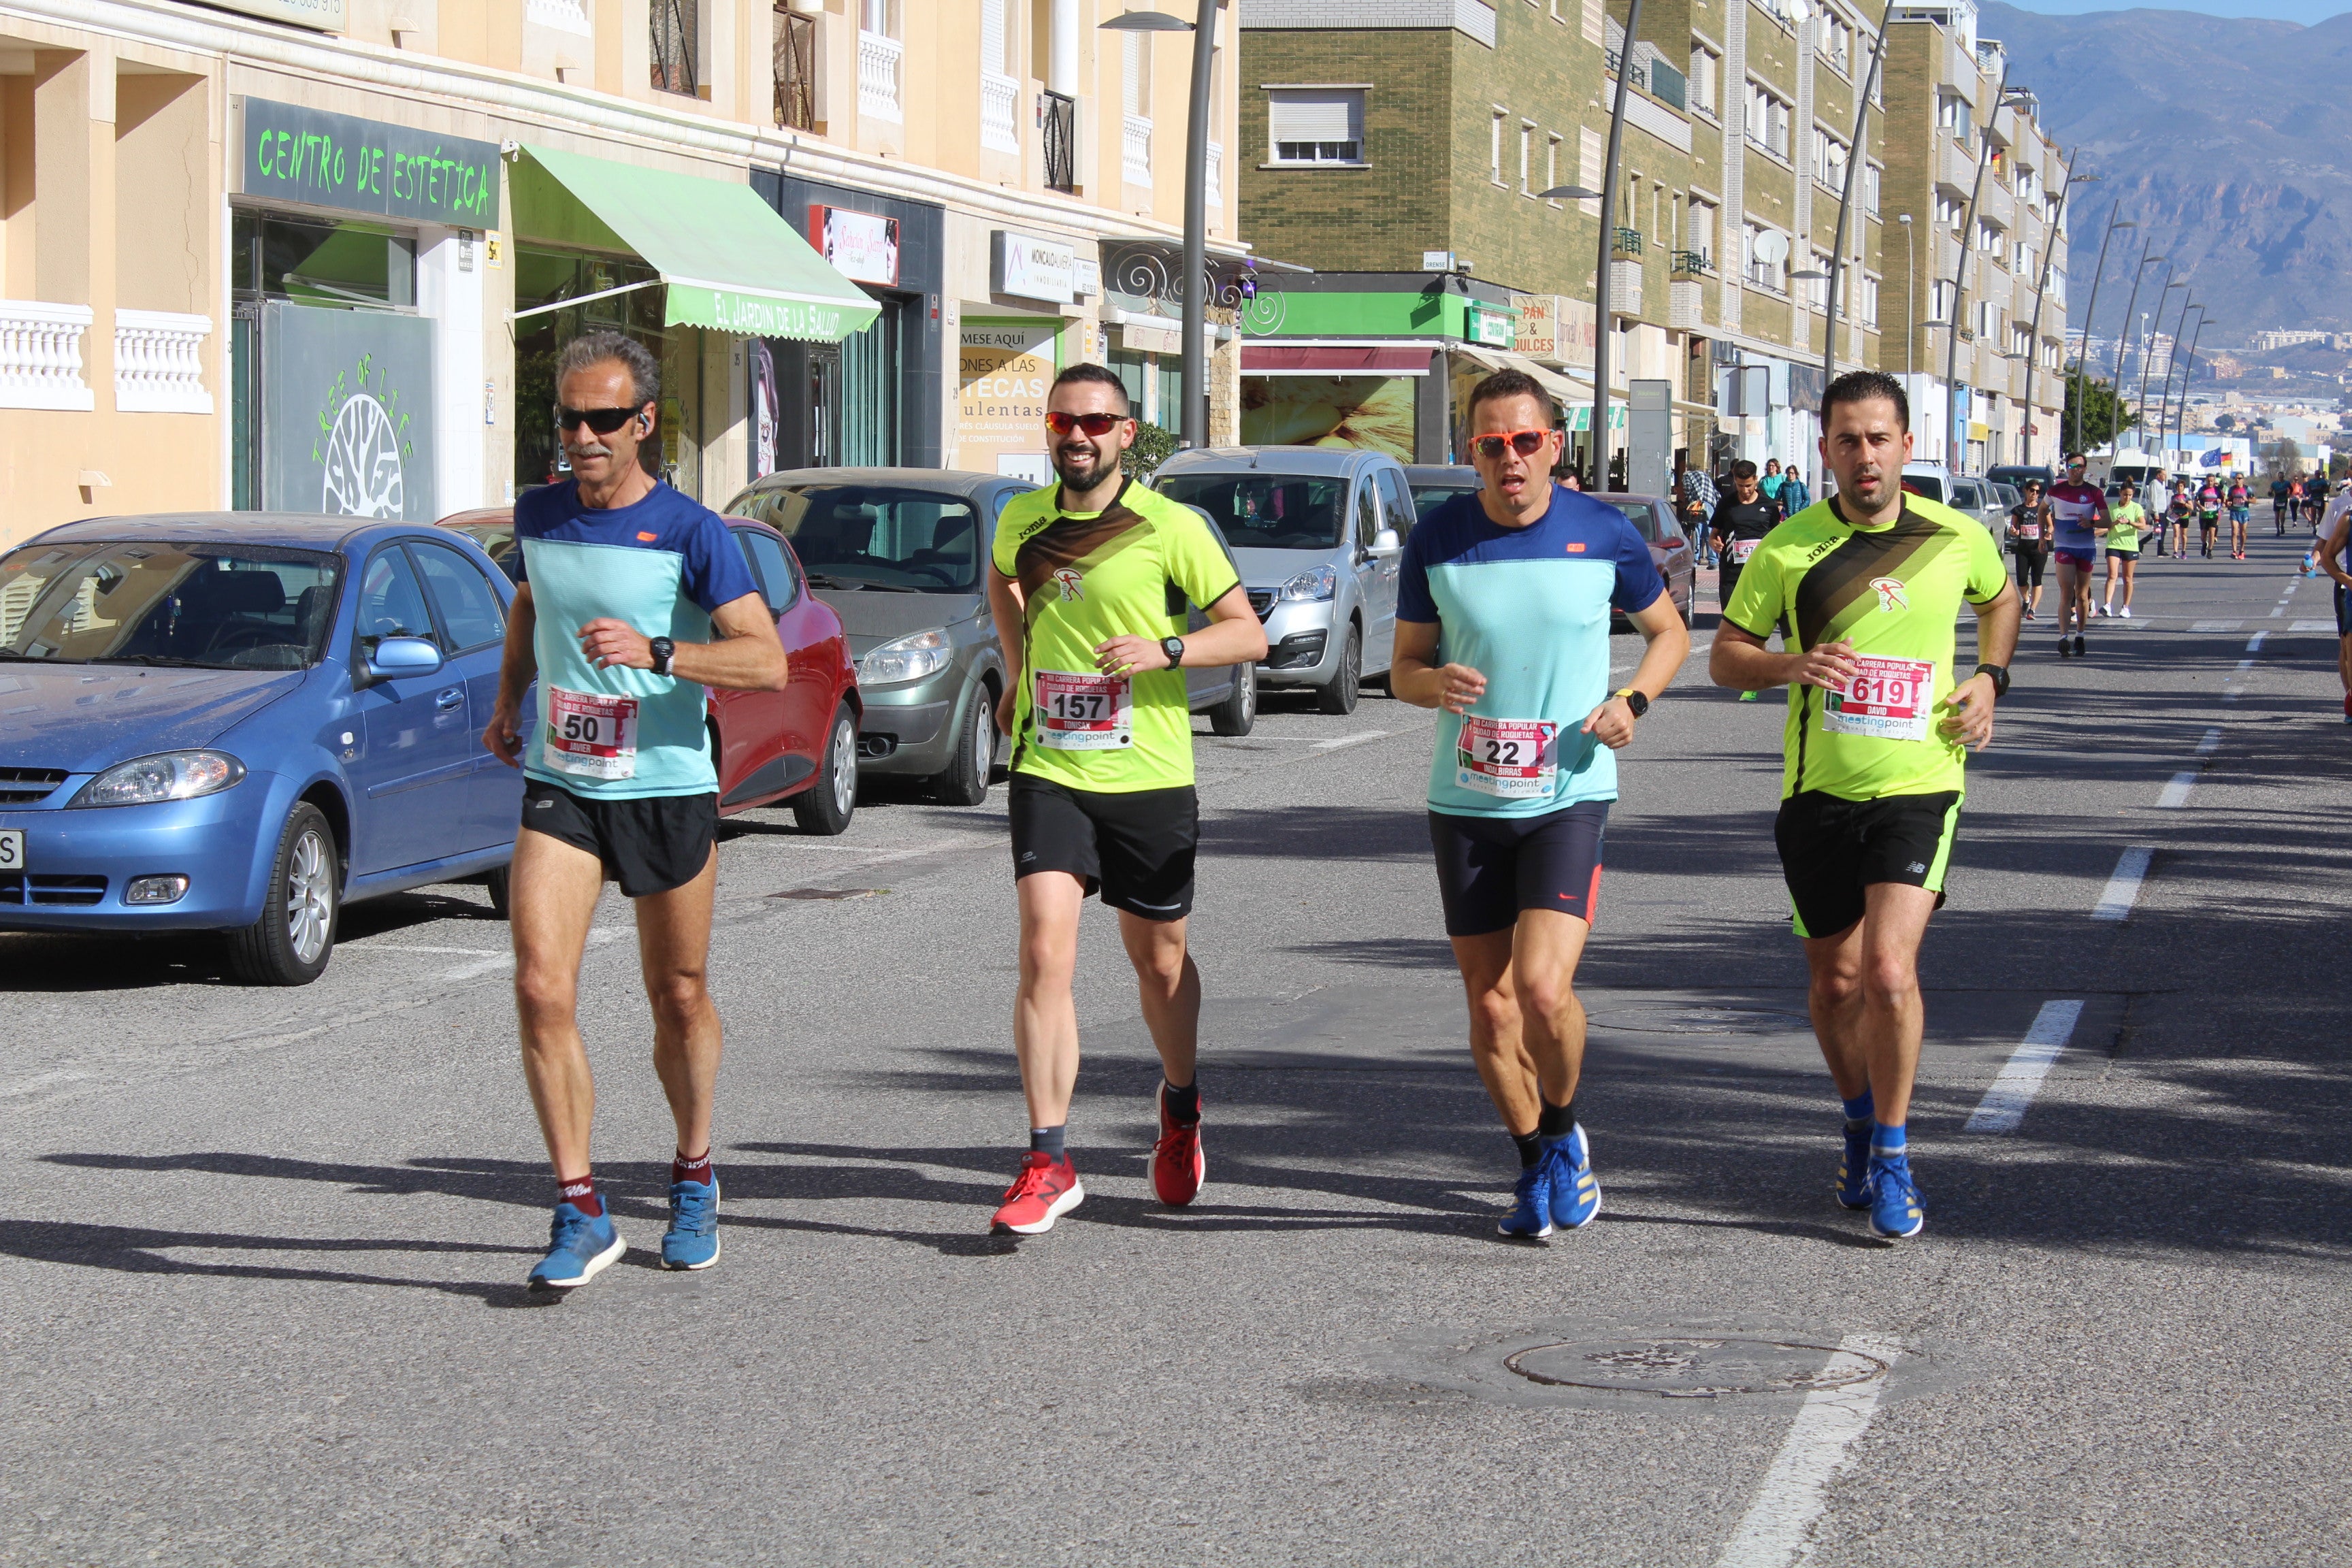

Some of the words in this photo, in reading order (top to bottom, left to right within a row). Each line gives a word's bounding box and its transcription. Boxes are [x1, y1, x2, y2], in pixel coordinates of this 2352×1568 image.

[259, 128, 345, 193] CENTRO
[357, 146, 384, 195] DE
[393, 145, 489, 216] ESTÉTICA
[733, 295, 774, 330] JARDIN
[808, 305, 840, 336] SALUD
[1522, 306, 1544, 319] PAN
[1529, 322, 1537, 335] &
[994, 331, 1025, 348] AQUÍ
[1513, 338, 1554, 352] DULCES
[998, 359, 1007, 372] A
[1011, 359, 1036, 372] LAS
[962, 377, 1045, 398] TECAS
[312, 370, 348, 466] TREE
[357, 353, 372, 391] OF
[378, 368, 413, 468] LIFE
[964, 401, 1043, 416] ulentas
[975, 421, 1014, 431] CLÁUSULA
[1015, 422, 1039, 431] SUELO
[968, 434, 1025, 443] CONSTITUCIÓN
[1806, 535, 1840, 562] Joma
[1857, 659, 1886, 669] CARRERA
[1055, 675, 1081, 684] CARRERA
[1082, 676, 1111, 685] POPULAR
[1879, 670, 1911, 679] ROQUETAS
[1075, 685, 1108, 693] ROQUETAS
[1852, 678, 1904, 704] 619
[589, 697, 619, 707] POPULAR
[1054, 694, 1103, 719] 157
[572, 703, 581, 713] DE
[582, 705, 614, 716] ROQUETAS
[1867, 706, 1887, 715] DAVID
[564, 715, 599, 742] 50
[1064, 721, 1091, 730] TONISAX
[1481, 719, 1507, 730] CARRERA
[1838, 715, 1913, 729] meetingpoint
[1473, 727, 1491, 736] CIUDAD
[570, 742, 591, 753] JAVIER
[1486, 740, 1519, 765] 22
[1484, 764, 1522, 777] INDALBIRRAS
[1470, 772, 1540, 789] meetingpoint
[0, 836, 14, 863] S
